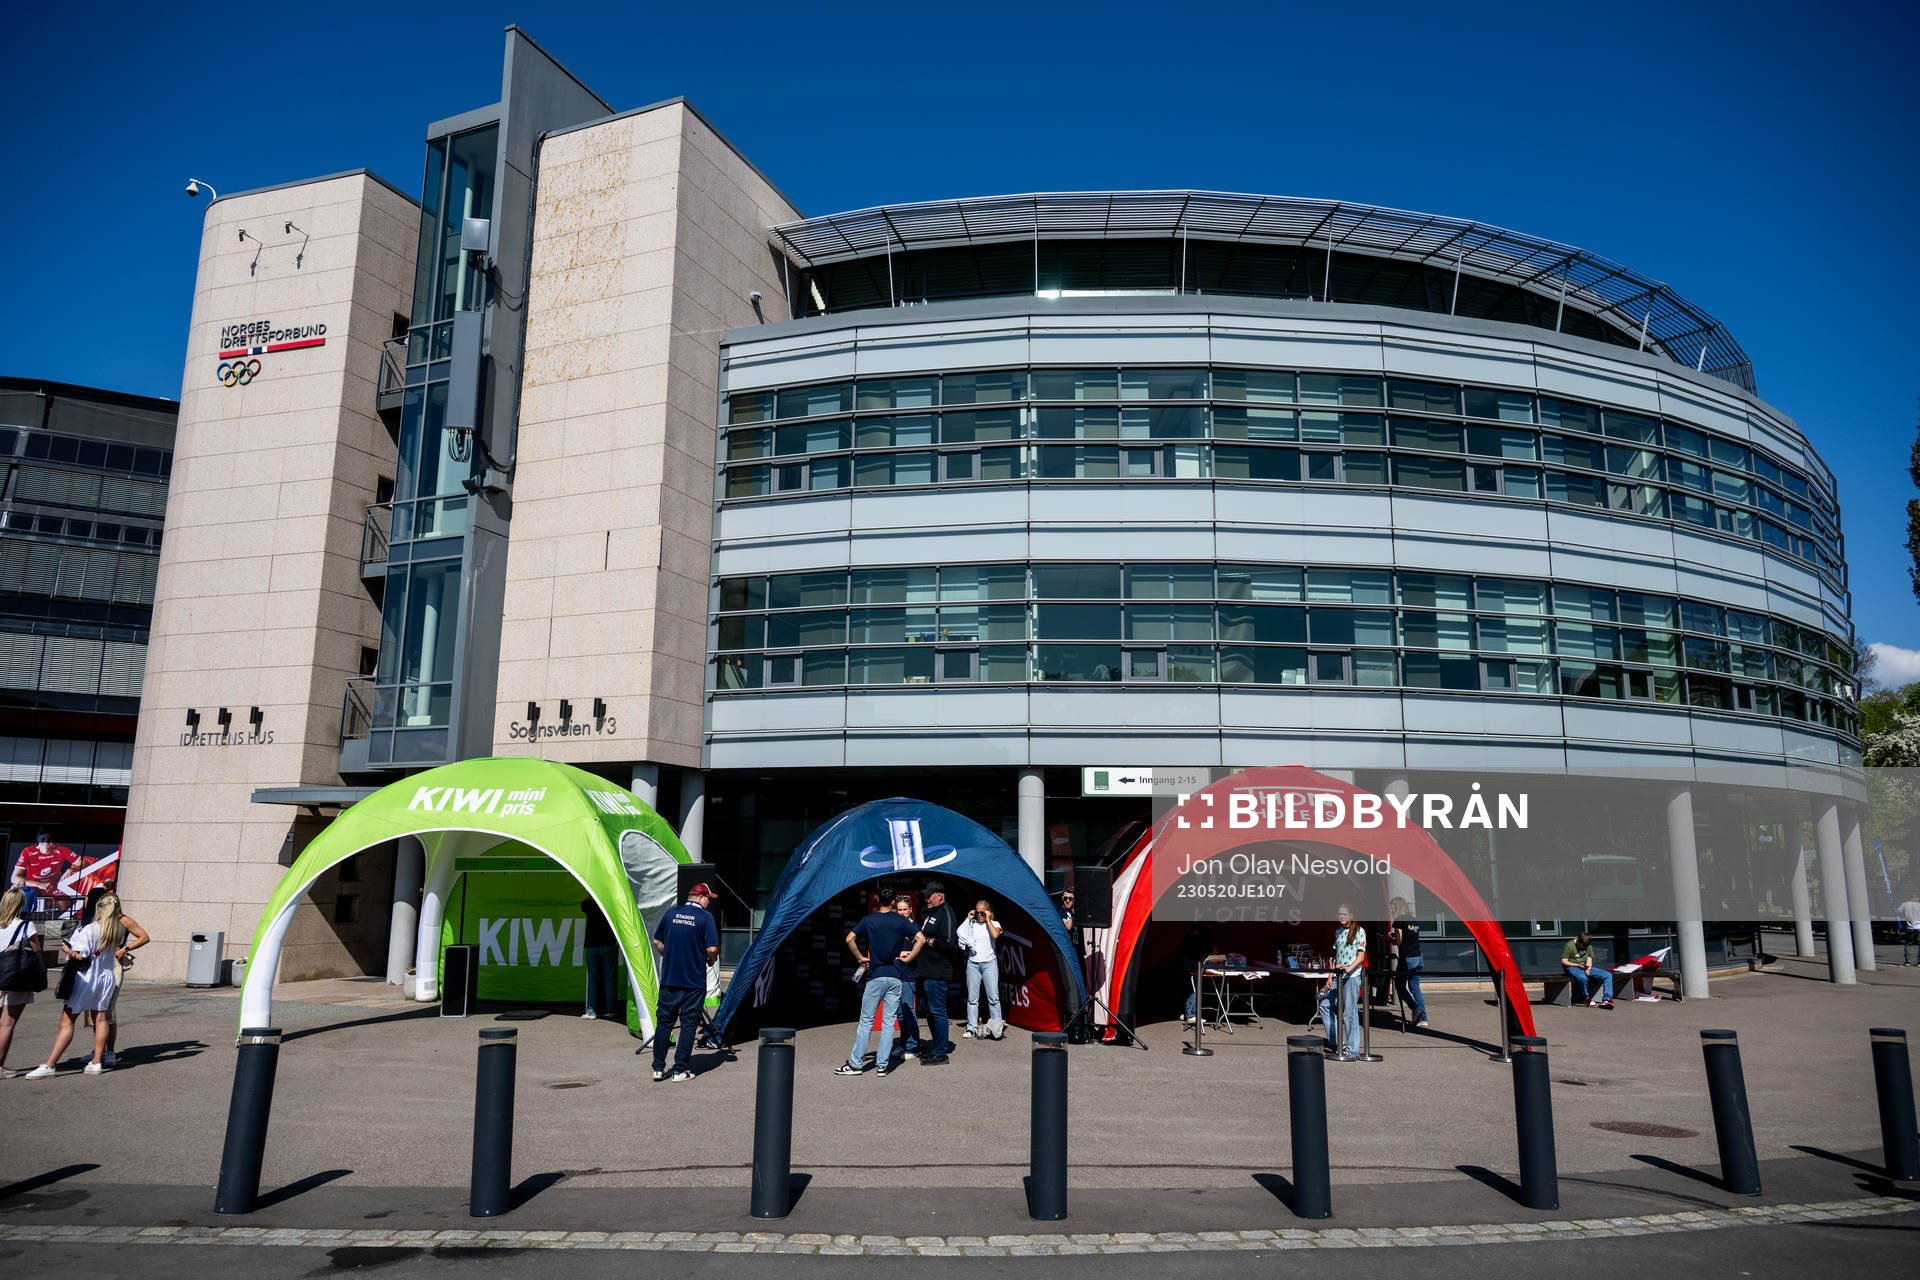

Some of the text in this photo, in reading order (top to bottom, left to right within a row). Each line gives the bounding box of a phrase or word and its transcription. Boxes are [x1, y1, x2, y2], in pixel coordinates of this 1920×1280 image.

[220, 324, 327, 348] IDRETTSFORBUND
[222, 321, 270, 337] NORGES
[248, 731, 275, 745] HUS
[509, 720, 591, 743] Sognsveien
[1139, 776, 1197, 786] Inngang 2-15
[407, 786, 548, 813] KIWI mini
[501, 801, 535, 818] pris
[672, 918, 696, 926] KONTROLL
[675, 913, 696, 921] STADION
[479, 918, 586, 967] KIWI
